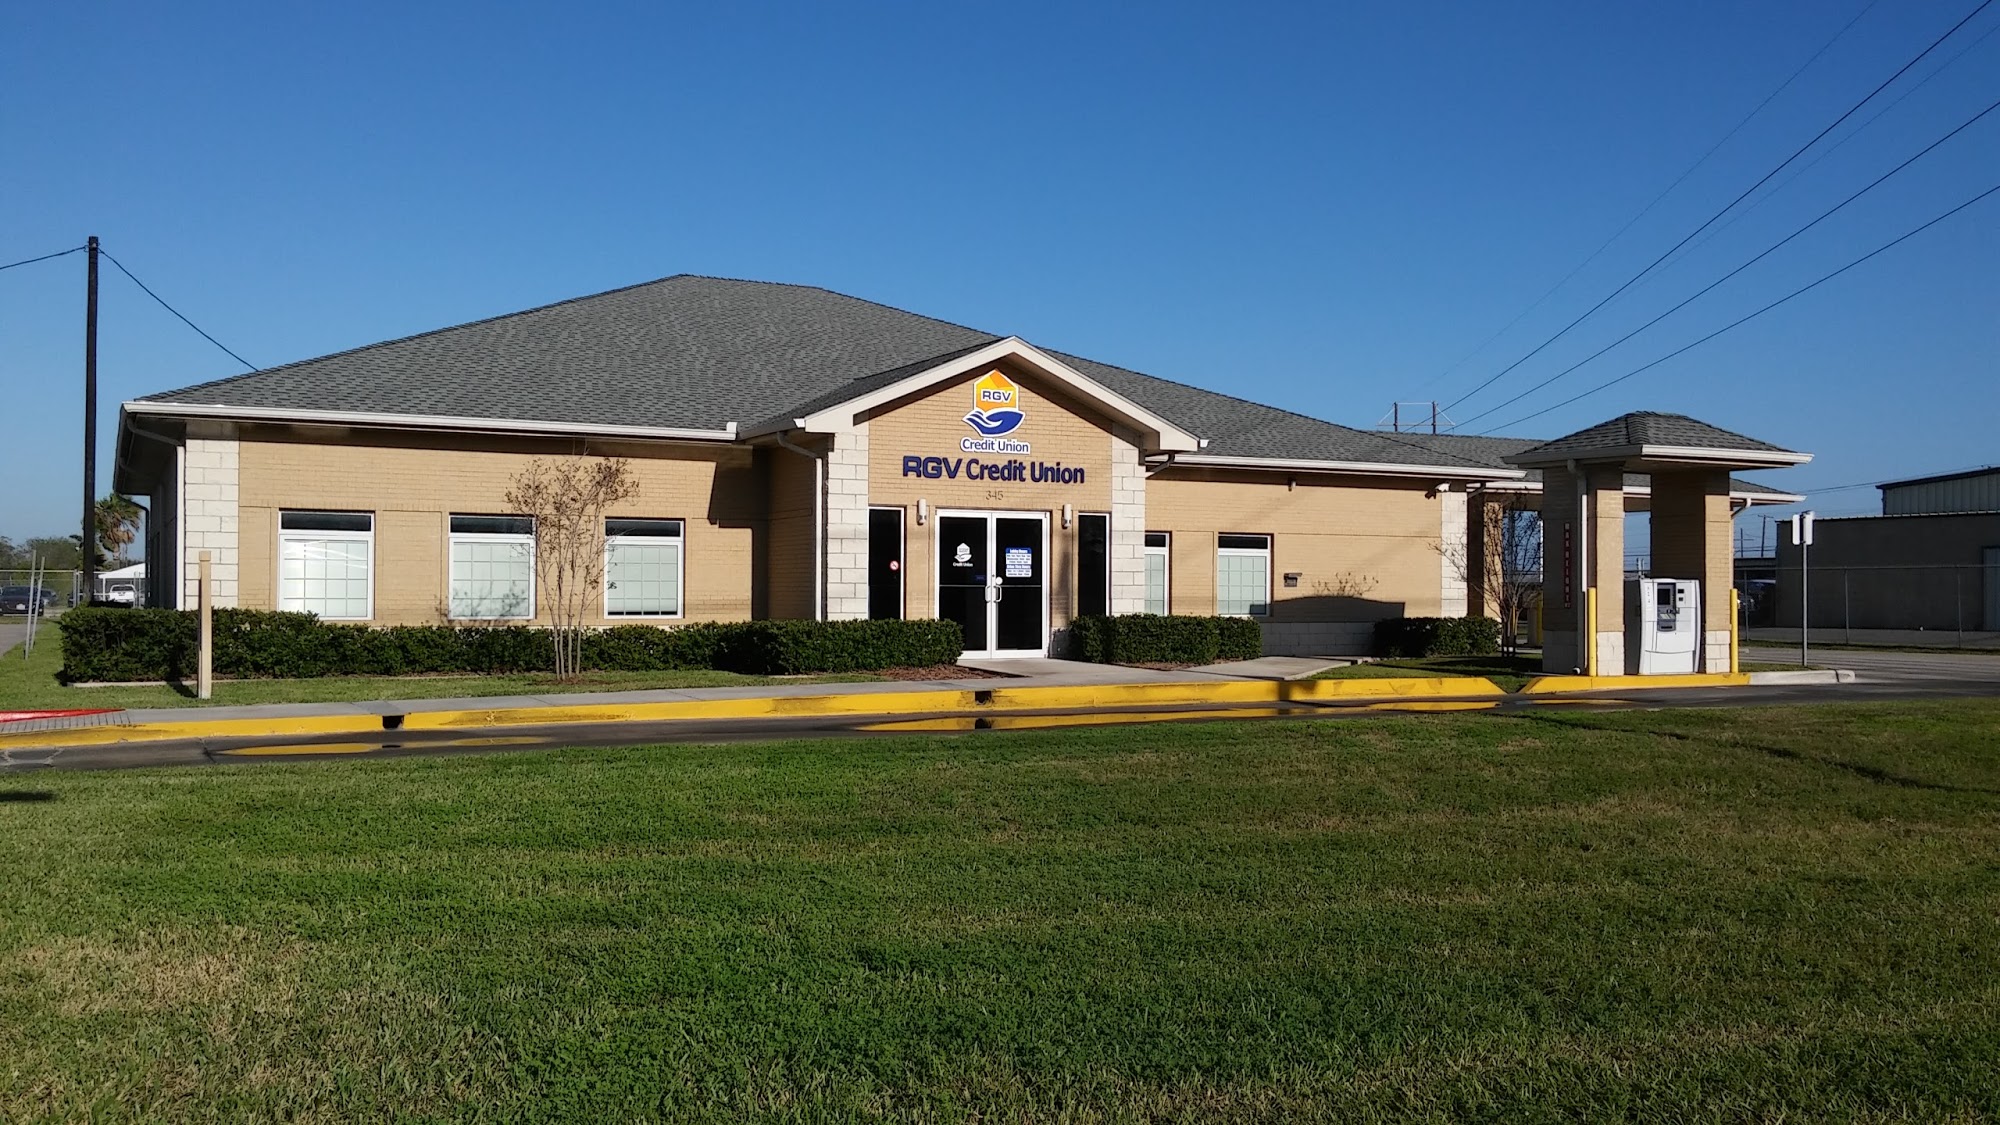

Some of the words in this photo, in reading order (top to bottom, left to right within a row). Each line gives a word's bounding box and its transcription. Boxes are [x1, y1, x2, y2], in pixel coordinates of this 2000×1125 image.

[982, 390, 1011, 402] RGV
[962, 438, 995, 451] Credit
[998, 440, 1029, 453] Union
[902, 455, 963, 479] RGV
[966, 458, 1026, 482] Credit
[1030, 461, 1085, 484] Union
[985, 490, 1004, 501] 345
